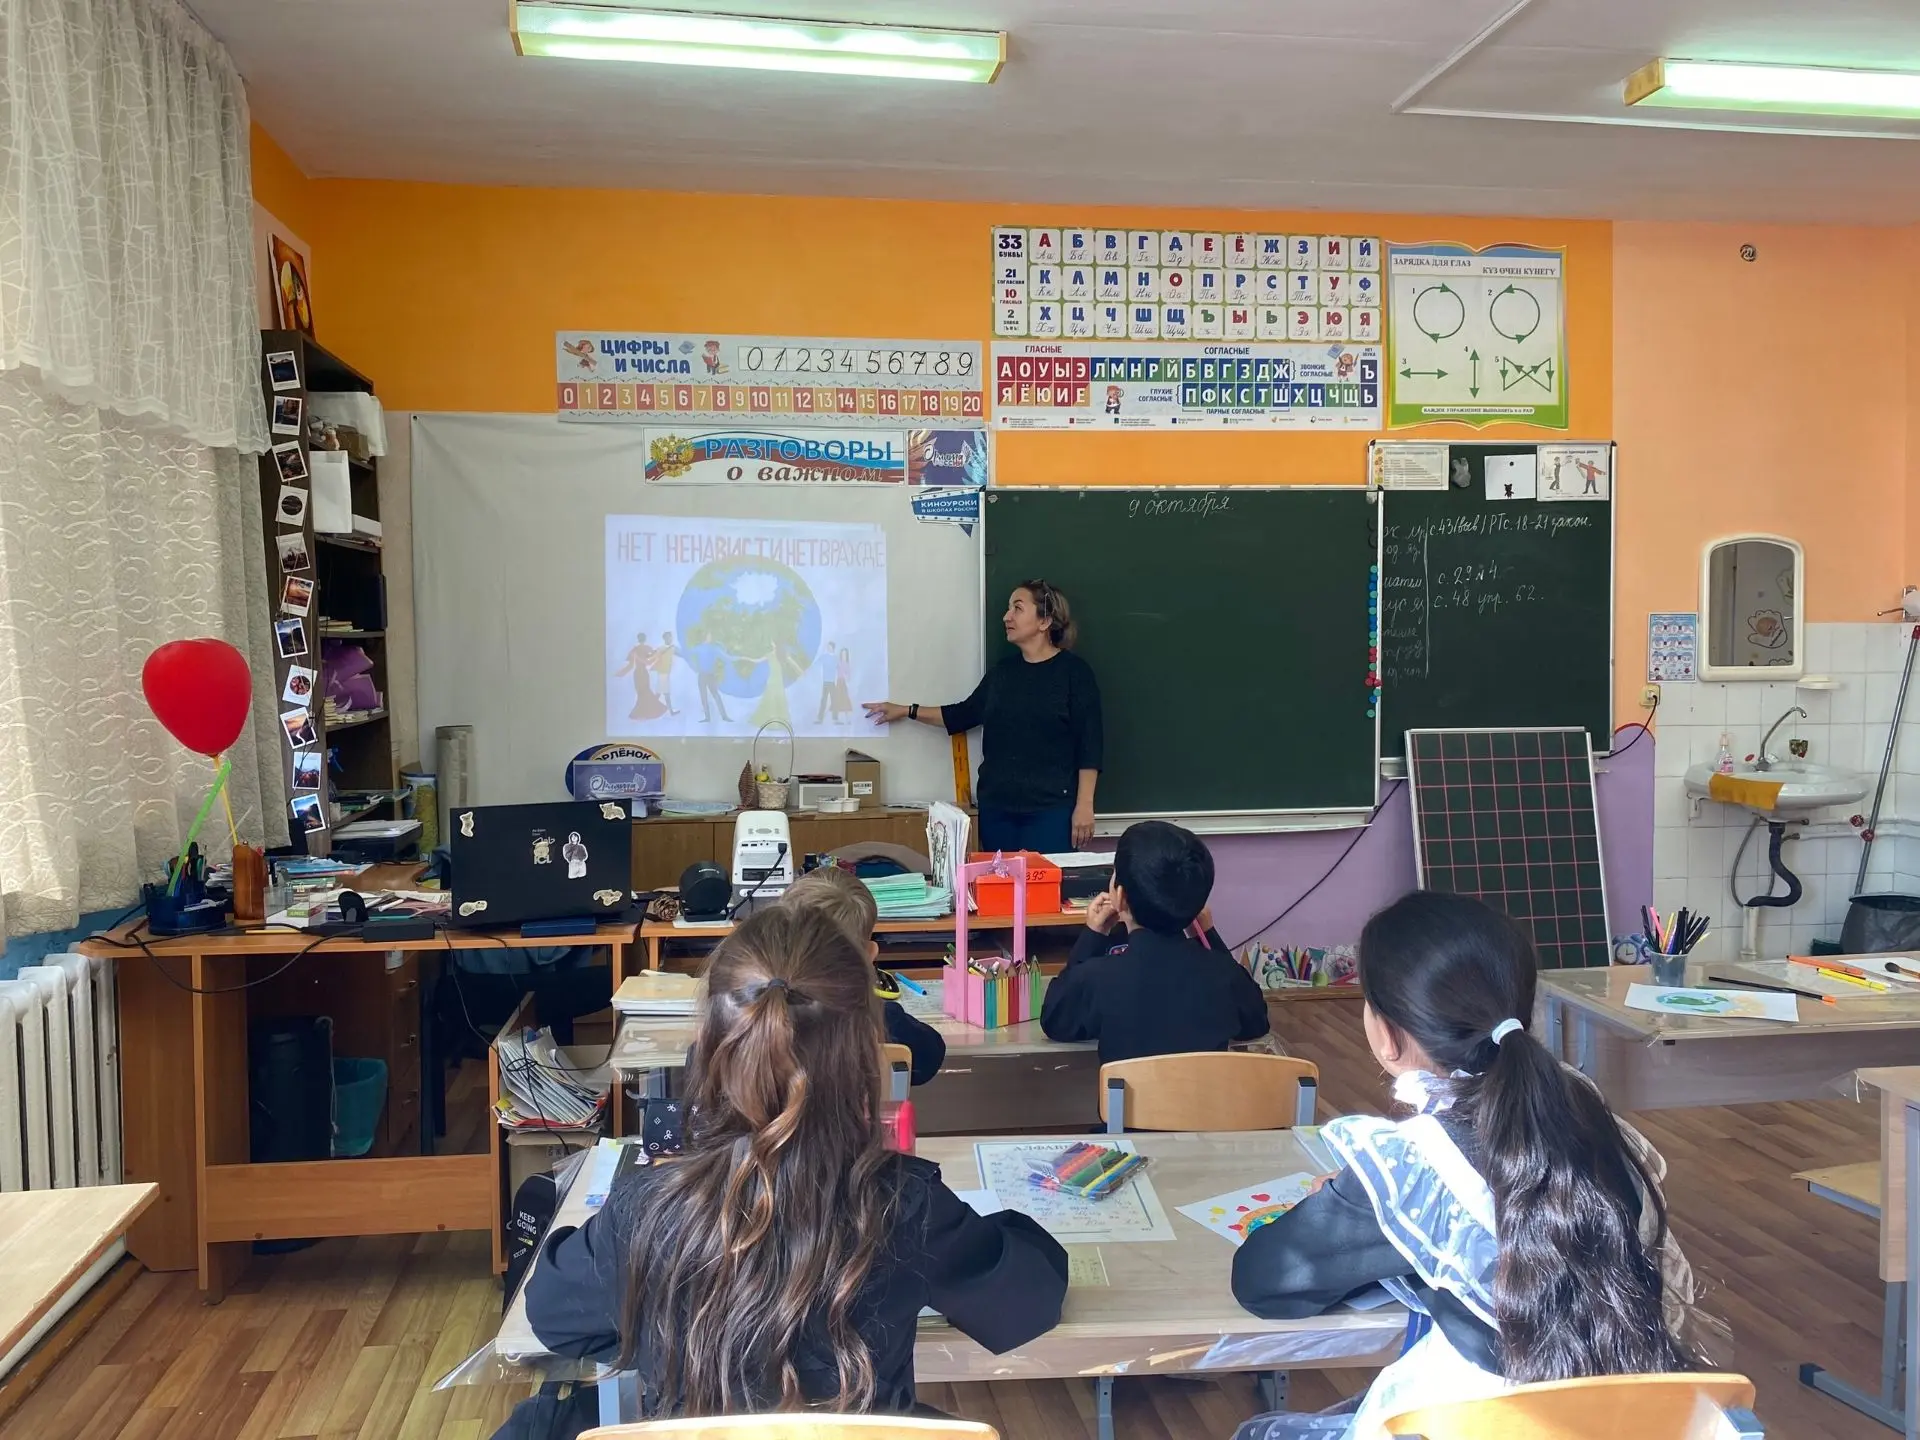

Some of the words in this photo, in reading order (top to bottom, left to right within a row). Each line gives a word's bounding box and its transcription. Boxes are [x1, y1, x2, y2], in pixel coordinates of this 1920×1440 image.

[999, 234, 1022, 250] 33
[1039, 233, 1051, 247] А
[1073, 234, 1083, 248] Б
[1106, 235, 1116, 248] В
[1139, 236, 1148, 249] Г
[1169, 237, 1182, 251] Д
[1204, 238, 1213, 251] Е
[1236, 236, 1244, 252] Ё
[1264, 240, 1279, 253] Ж
[1298, 241, 1308, 254] З
[1328, 241, 1340, 254] И
[1360, 238, 1370, 255] Й
[1393, 258, 1430, 266] ЗАРЯДКА
[1432, 259, 1448, 267] ДЛЯ
[1450, 259, 1471, 267] ГЛАЗ
[1005, 269, 1016, 277] 21
[1040, 270, 1050, 284] К
[1073, 271, 1084, 284] Л
[1104, 271, 1118, 285] М
[1138, 272, 1149, 286] Н
[1170, 273, 1182, 286] О
[1203, 274, 1213, 287] П
[1236, 274, 1246, 287] Р
[1267, 275, 1276, 289] С
[1298, 276, 1308, 289] Т
[1329, 277, 1339, 289] У
[1359, 277, 1371, 290] Ф
[1005, 289, 1016, 298] 10
[1008, 310, 1014, 319] 2
[1040, 306, 1051, 320] Х
[1072, 307, 1084, 321] Ц
[1106, 308, 1116, 321] Ч
[1136, 309, 1151, 322] Ш
[1167, 309, 1184, 325] Щ
[1201, 310, 1214, 322] Ъ
[1233, 310, 1247, 323] Ы
[1266, 311, 1277, 324] Ь
[1298, 311, 1308, 324] Э
[1327, 312, 1342, 325] Ю
[1360, 312, 1370, 325] Я
[600, 340, 670, 355] ЦИФРЫ
[1204, 347, 1250, 355] СОГЛАСНЫЕ
[615, 359, 627, 372] И
[631, 359, 690, 374] ЧИСЛА
[747, 346, 763, 371] 0
[774, 348, 787, 371] 1
[796, 349, 811, 372] 2
[817, 349, 834, 372] 3
[840, 350, 852, 372] 4
[866, 351, 881, 374] 5
[888, 351, 904, 374] 6
[910, 351, 927, 375] 7
[934, 352, 950, 375] 8
[957, 352, 973, 376] 9
[1001, 363, 1012, 377] А
[1020, 362, 1030, 377] О
[1039, 363, 1049, 377] У
[1055, 363, 1069, 377] Ы
[1076, 363, 1086, 377] Э
[1094, 363, 1105, 377] Л
[1111, 363, 1124, 377] М
[1131, 363, 1141, 378] Н
[1150, 363, 1158, 377] Р
[1167, 360, 1177, 378] Й
[1186, 364, 1196, 378] Б
[1204, 364, 1213, 378] В
[1223, 364, 1231, 378] Г
[1241, 364, 1249, 378] З
[1257, 364, 1270, 381] Д
[1274, 364, 1289, 378] Ж
[1362, 365, 1375, 378] Ъ
[563, 388, 573, 404] 0
[585, 388, 591, 404] 1
[603, 389, 612, 405] 2
[622, 389, 631, 405] 3
[640, 389, 651, 405] 4
[660, 390, 669, 405] 5
[679, 390, 688, 406] 6
[698, 391, 706, 406] 7
[717, 391, 726, 407] 8
[736, 391, 744, 407] 9
[751, 392, 768, 407] 10
[776, 392, 788, 408] 11
[795, 393, 811, 408] 12
[818, 393, 833, 408] 13
[838, 393, 854, 408] 14
[860, 394, 875, 409] 15
[881, 394, 896, 410] 16
[902, 395, 916, 410] 17
[922, 396, 938, 411] 18
[944, 396, 959, 411] 19
[964, 396, 981, 412] 20
[1002, 388, 1011, 403] Я
[1021, 384, 1029, 402] Ё
[1037, 388, 1051, 403] Ю
[1057, 388, 1068, 402] И
[1077, 388, 1085, 403] Е
[1186, 389, 1196, 403] П
[1202, 388, 1216, 403] Ф
[1222, 389, 1232, 403] К
[1241, 389, 1249, 403] С
[1259, 389, 1268, 403] Т
[1274, 389, 1289, 403] Ш
[1294, 389, 1304, 403] Х
[1311, 389, 1322, 406] Ц
[1330, 389, 1339, 403] Ч
[1344, 389, 1359, 406] Щ
[1364, 389, 1373, 403] Ь
[705, 439, 891, 461] РАЗГОВОРЫ
[757, 465, 882, 482] важном
[1129, 499, 1140, 518] 9
[618, 532, 657, 562] НЕТ
[666, 534, 785, 563] НЕНАВИСТИ
[786, 538, 818, 566] НЕТ
[520, 1211, 535, 1223] KEEP
[517, 1219, 536, 1234] GOING
